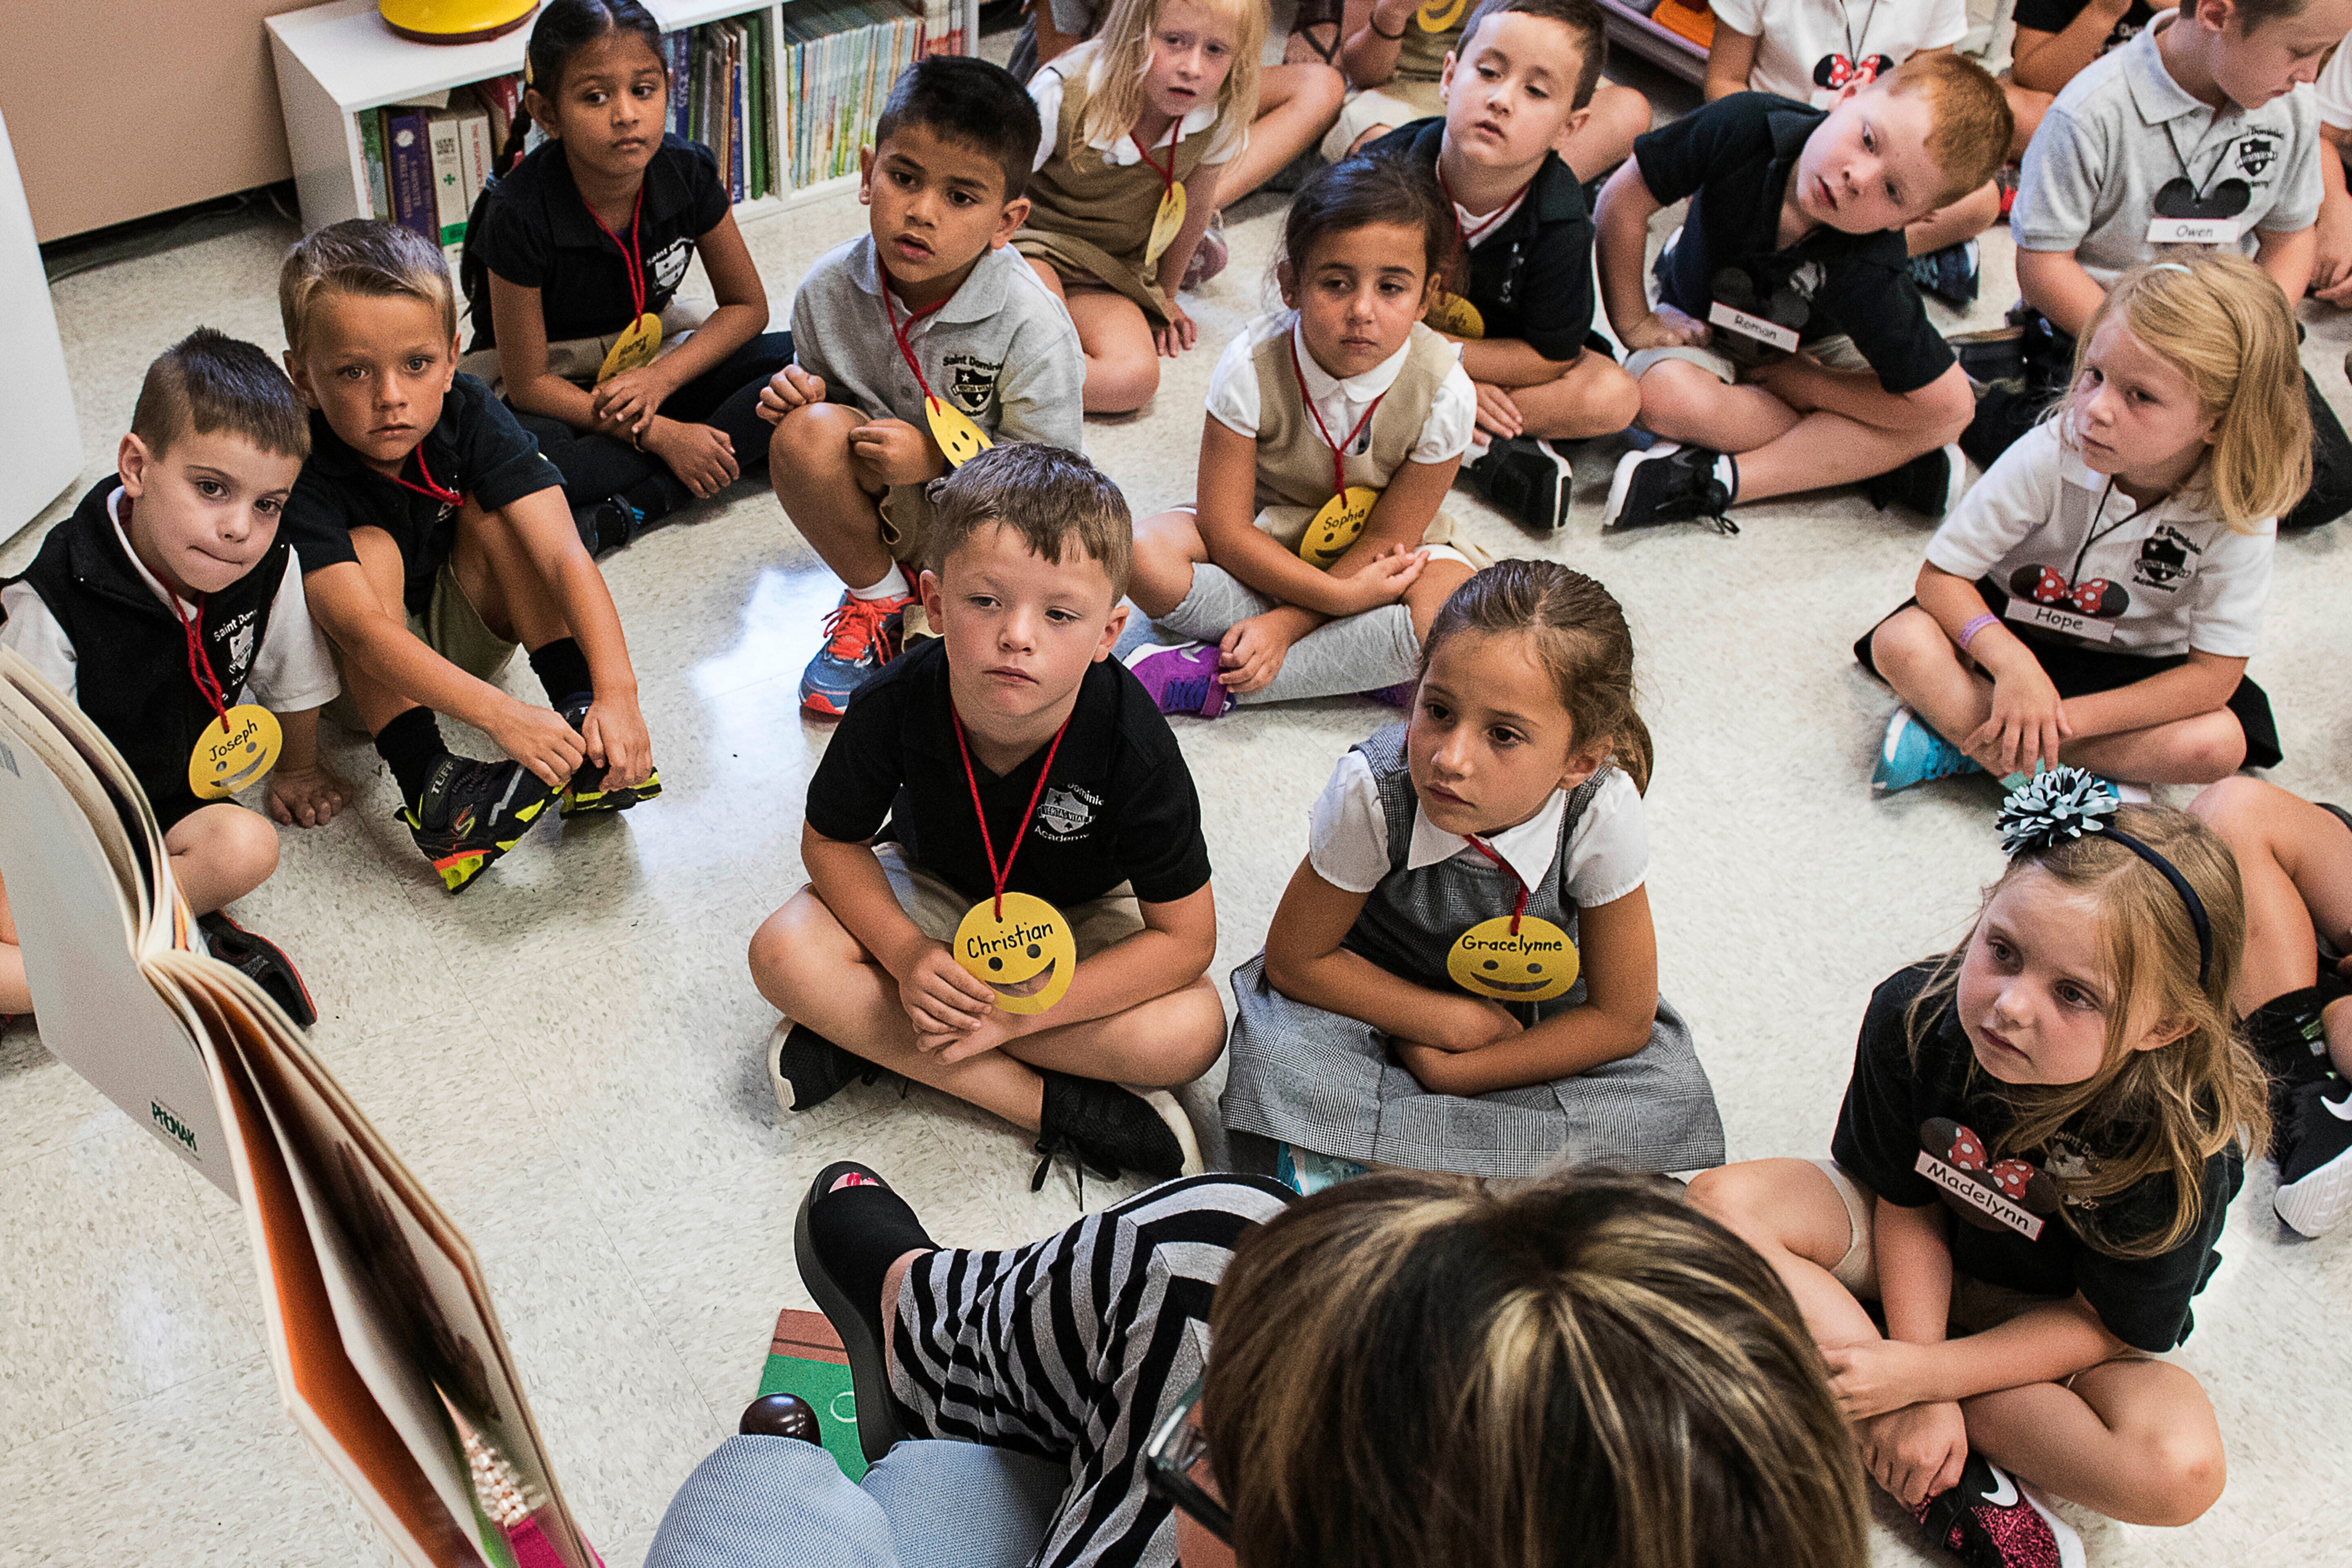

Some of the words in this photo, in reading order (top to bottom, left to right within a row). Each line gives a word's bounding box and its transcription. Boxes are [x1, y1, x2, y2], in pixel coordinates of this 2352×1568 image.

[2176, 225, 2214, 238] Owen
[1734, 314, 1777, 340] Roman
[942, 354, 967, 366] Saint
[1323, 505, 1365, 531] Sophia
[214, 619, 238, 642] Saint
[2034, 608, 2084, 631] Hope
[209, 719, 258, 763] Joseph
[1044, 806, 1067, 818] VERITAS
[967, 922, 1054, 959] Christian
[1461, 934, 1563, 956] Gracelynne
[1927, 1161, 2030, 1232] Madelynn
